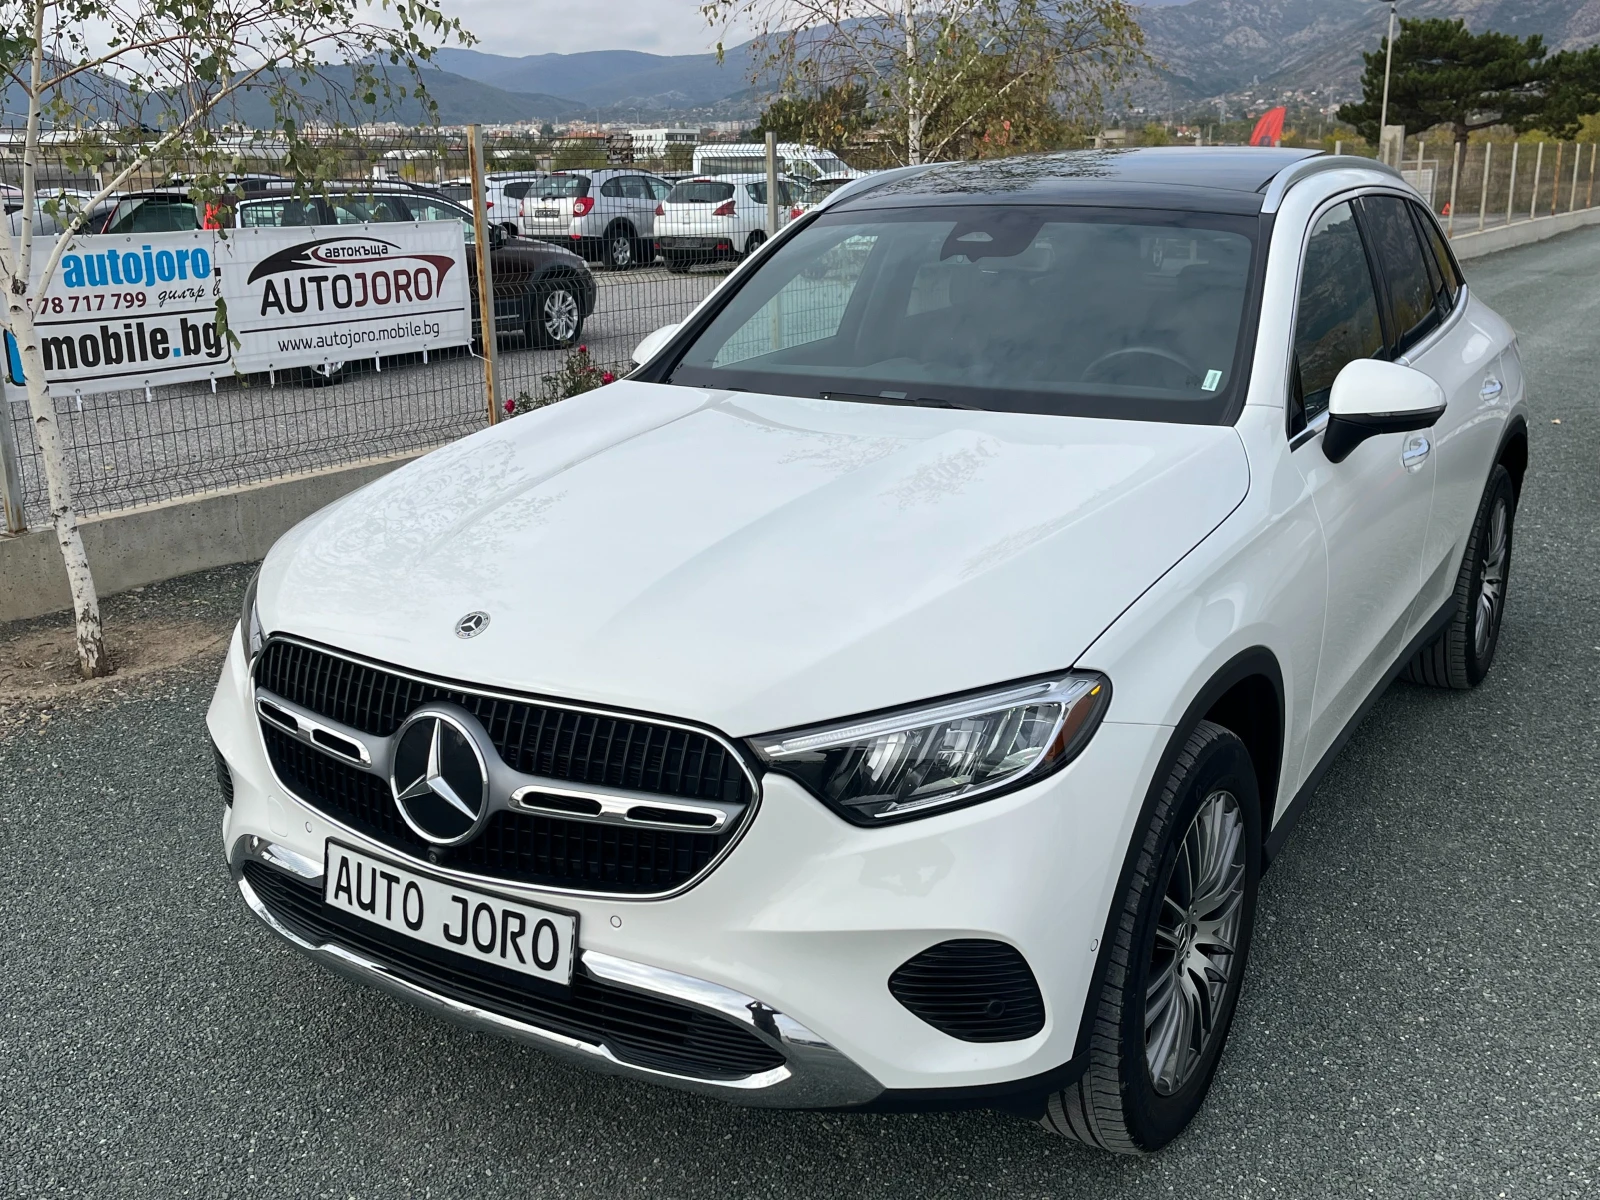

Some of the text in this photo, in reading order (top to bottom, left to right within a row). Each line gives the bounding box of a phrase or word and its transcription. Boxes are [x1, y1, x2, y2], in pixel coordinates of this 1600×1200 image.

[325, 243, 389, 259] автокъща
[68, 294, 105, 313] 717
[110, 291, 147, 310] 799
[260, 267, 433, 316] AUTOJORO
[41, 318, 222, 370] mobile.bg
[277, 320, 440, 352] www.autojoro.mobile.bg
[334, 856, 559, 971] AUTO JORO
